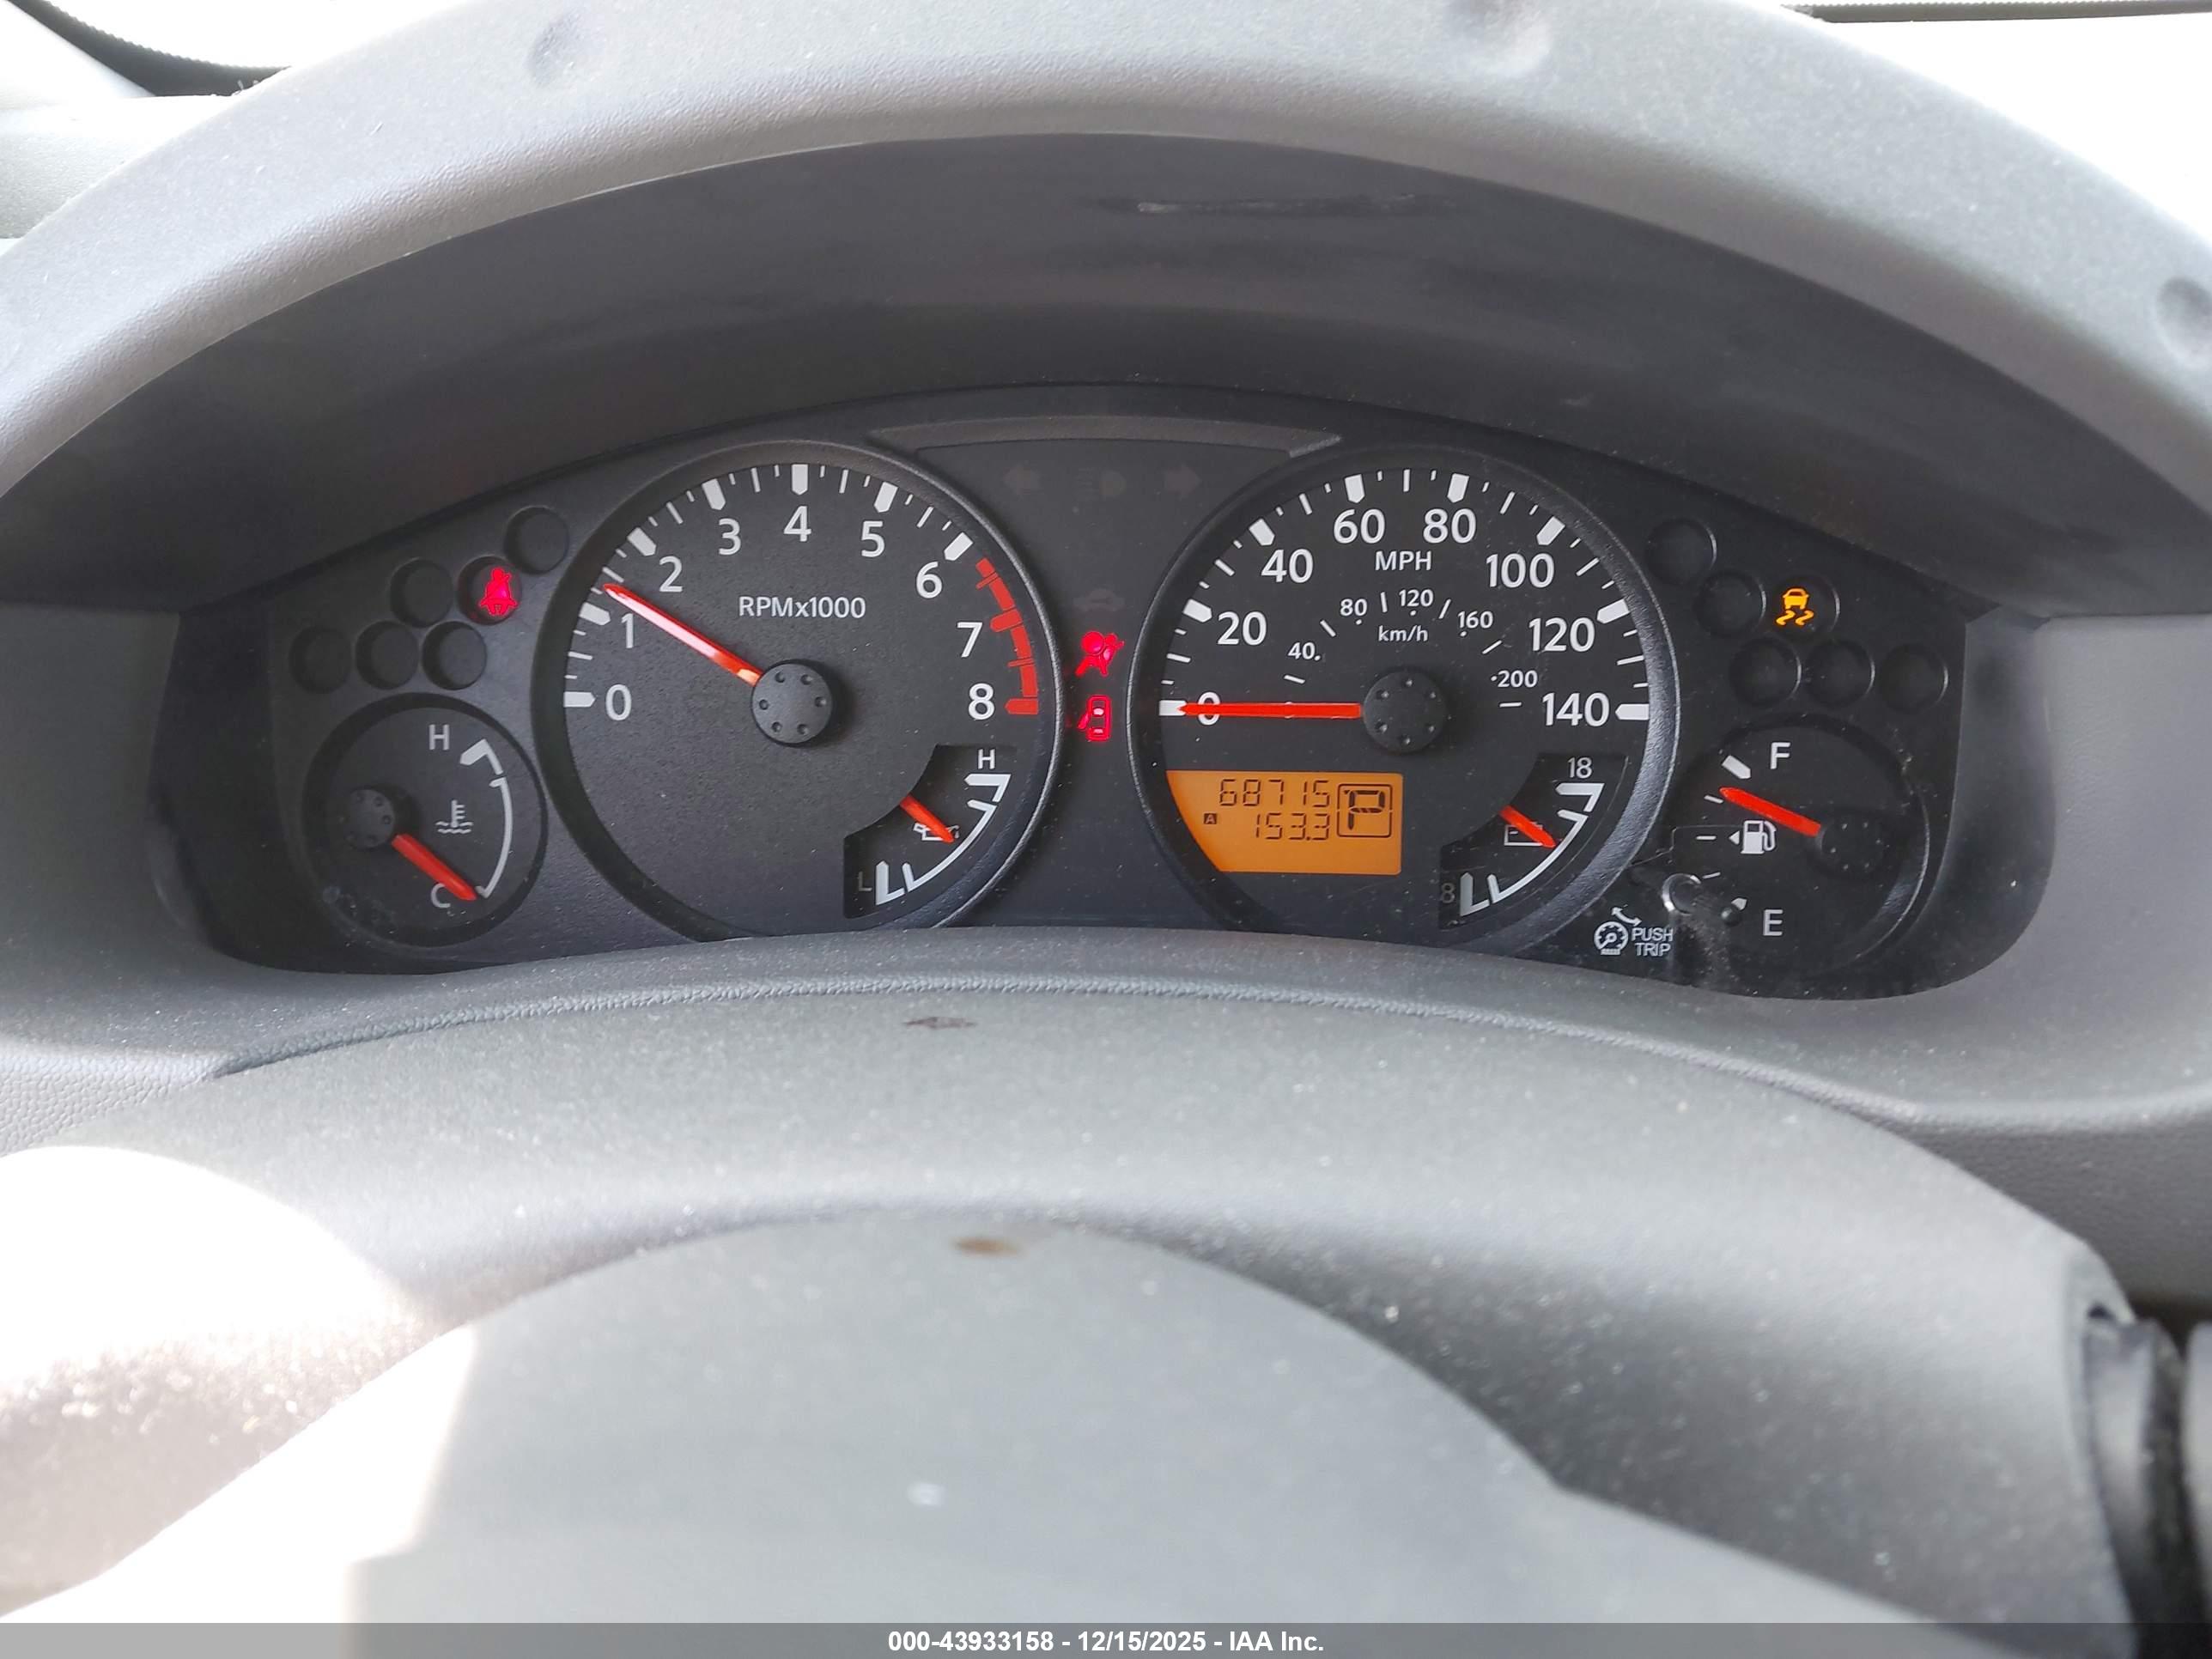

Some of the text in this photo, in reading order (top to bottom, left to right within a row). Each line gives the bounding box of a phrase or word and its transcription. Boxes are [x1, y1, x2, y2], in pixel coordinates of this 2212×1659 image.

[719, 519, 741, 555] 3
[784, 506, 811, 542] 4
[1334, 509, 1385, 544] 60
[1423, 509, 1476, 544] 80
[861, 521, 885, 557] 5
[659, 556, 683, 592] 2
[1261, 549, 1314, 582] 40
[1376, 551, 1431, 571] MPH
[1486, 554, 1554, 587] 100
[916, 562, 943, 599] 6
[739, 597, 866, 618] RPMx1000
[1340, 599, 1368, 617] 80
[1399, 589, 1434, 607] 120
[621, 612, 634, 648] 1
[1218, 611, 1267, 645] 20
[1378, 625, 1428, 642] km/h
[1458, 611, 1493, 629] 160
[957, 622, 983, 658] 7
[1529, 617, 1595, 653] 120
[1288, 642, 1314, 660] 40
[1497, 670, 1538, 688] 200
[605, 684, 632, 721] 0
[968, 684, 995, 720] 8
[1198, 691, 1220, 726] 0
[1543, 693, 1610, 727] 140
[428, 725, 450, 750] H
[977, 749, 995, 769] H
[1569, 757, 1593, 778] 18
[1770, 742, 1791, 769] F
[1219, 779, 1330, 807] 68715
[1344, 789, 1386, 831] P
[1255, 812, 1330, 841] 153.3
[430, 882, 452, 908] C
[857, 872, 873, 892] L
[1442, 883, 1455, 903] 8
[1632, 927, 1674, 942] PUSH
[1762, 908, 1784, 937] E
[1634, 942, 1671, 957] TRIP
